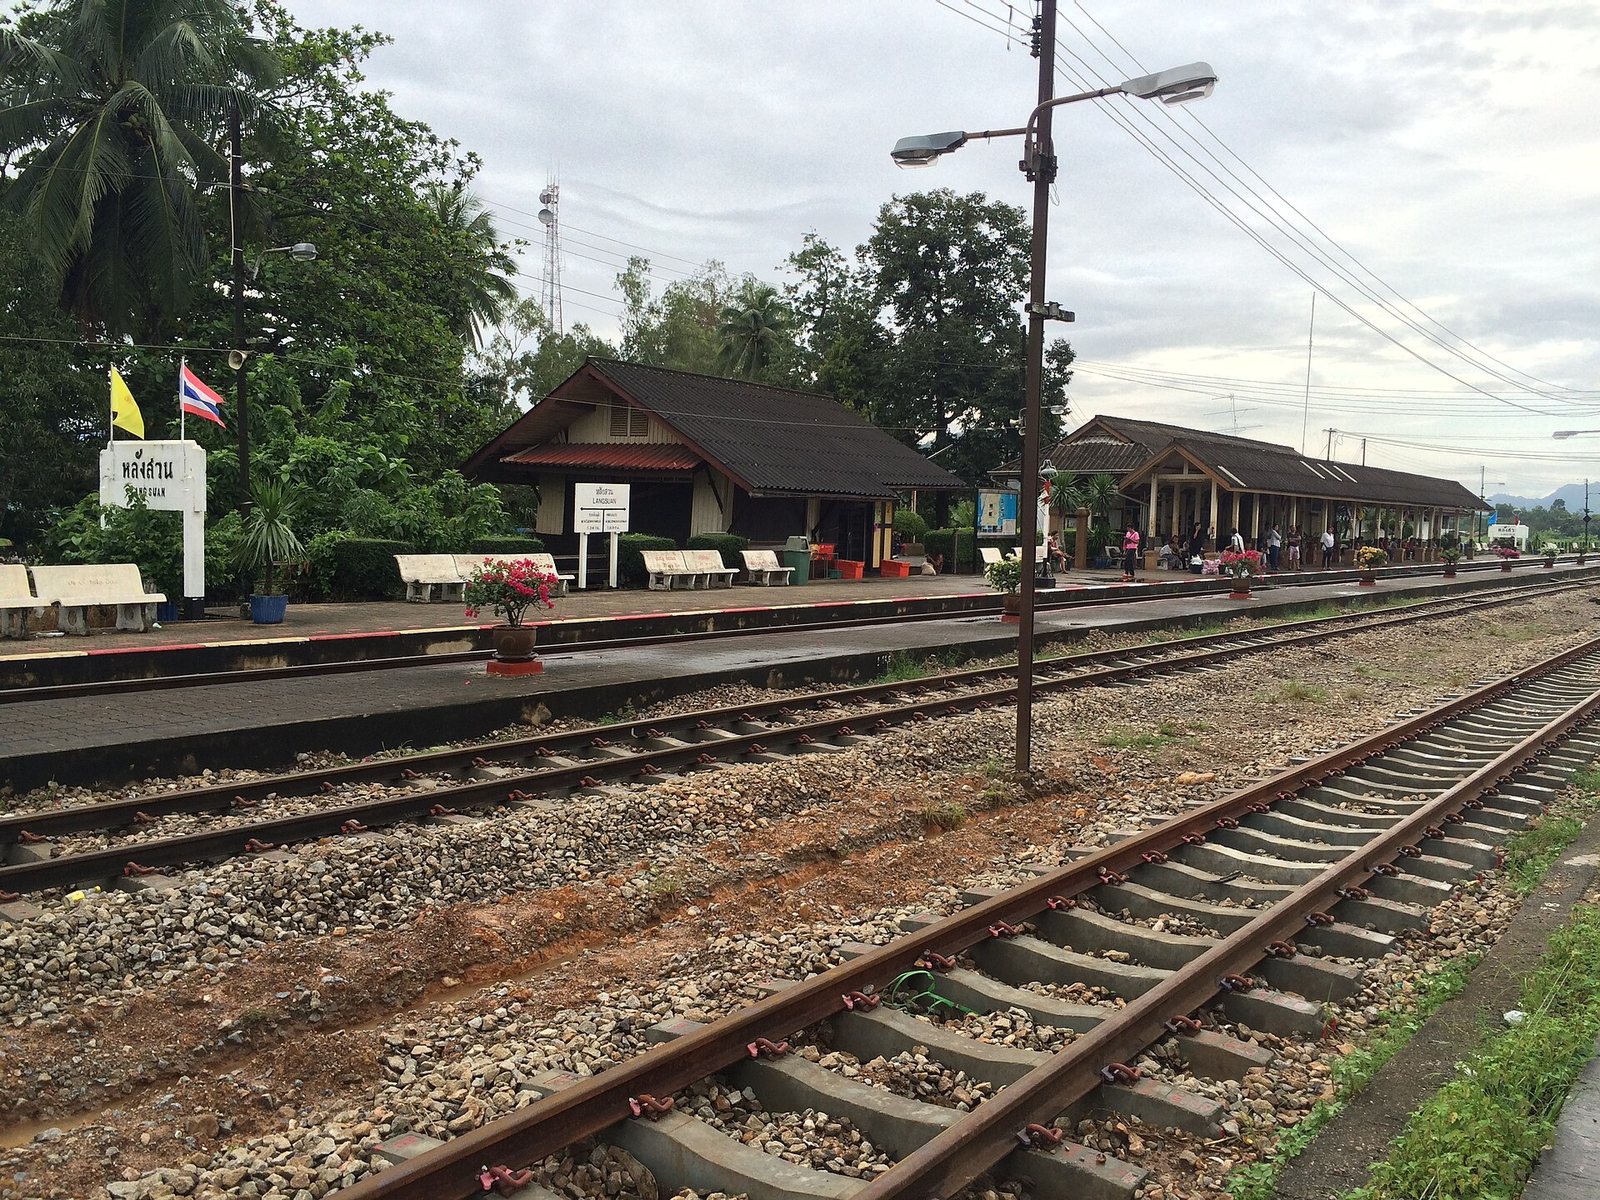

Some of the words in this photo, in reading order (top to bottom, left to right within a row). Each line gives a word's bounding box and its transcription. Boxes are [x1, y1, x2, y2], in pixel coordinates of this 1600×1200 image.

[122, 448, 174, 479] หลังสวน
[592, 497, 617, 505] LANGSUAN
